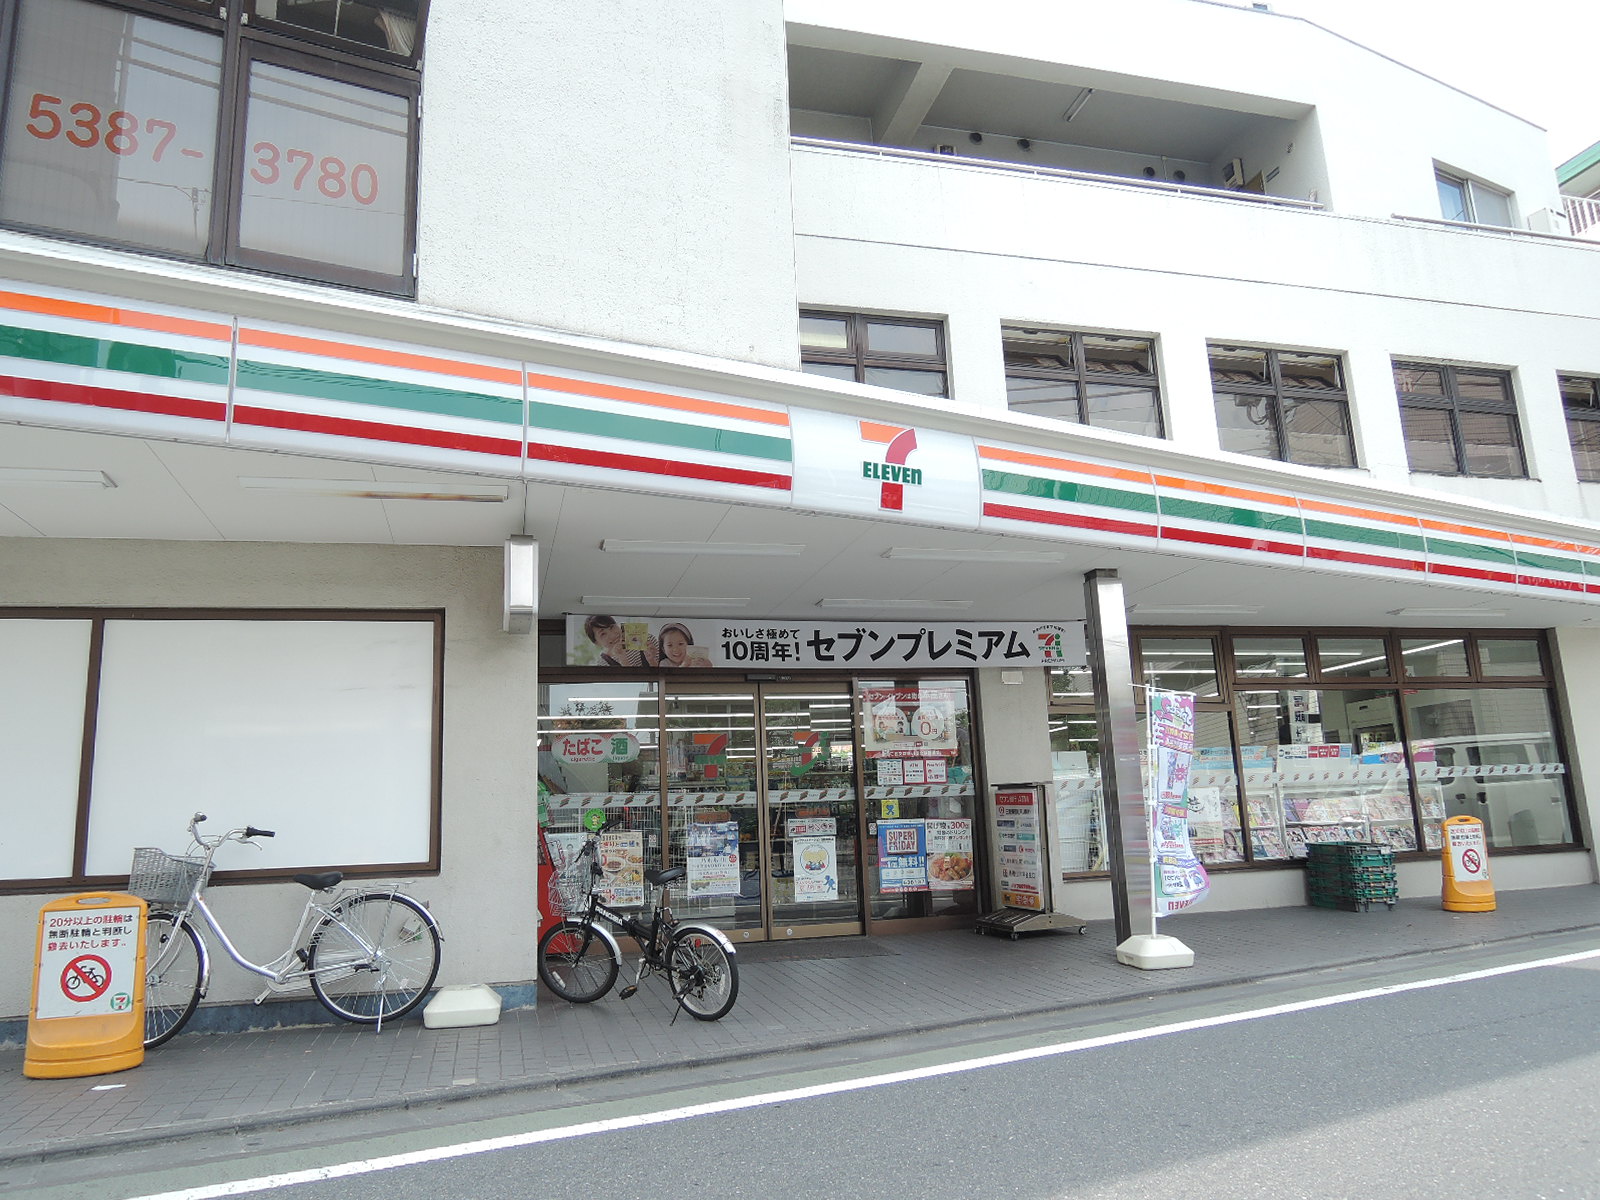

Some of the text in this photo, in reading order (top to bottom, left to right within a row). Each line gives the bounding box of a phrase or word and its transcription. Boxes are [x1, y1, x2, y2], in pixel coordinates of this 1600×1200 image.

[249, 141, 379, 205] 3780
[721, 627, 799, 639] おいしさ極めて
[721, 641, 799, 662] 10周年!
[806, 628, 1031, 662] セブンプレミアム
[563, 737, 603, 756] たばこ
[611, 737, 628, 755] 酒
[889, 840, 915, 851] FRIDAY
[50, 914, 133, 927] 20分以上の駐輪は
[49, 926, 132, 938] 無断駐輪と判断し
